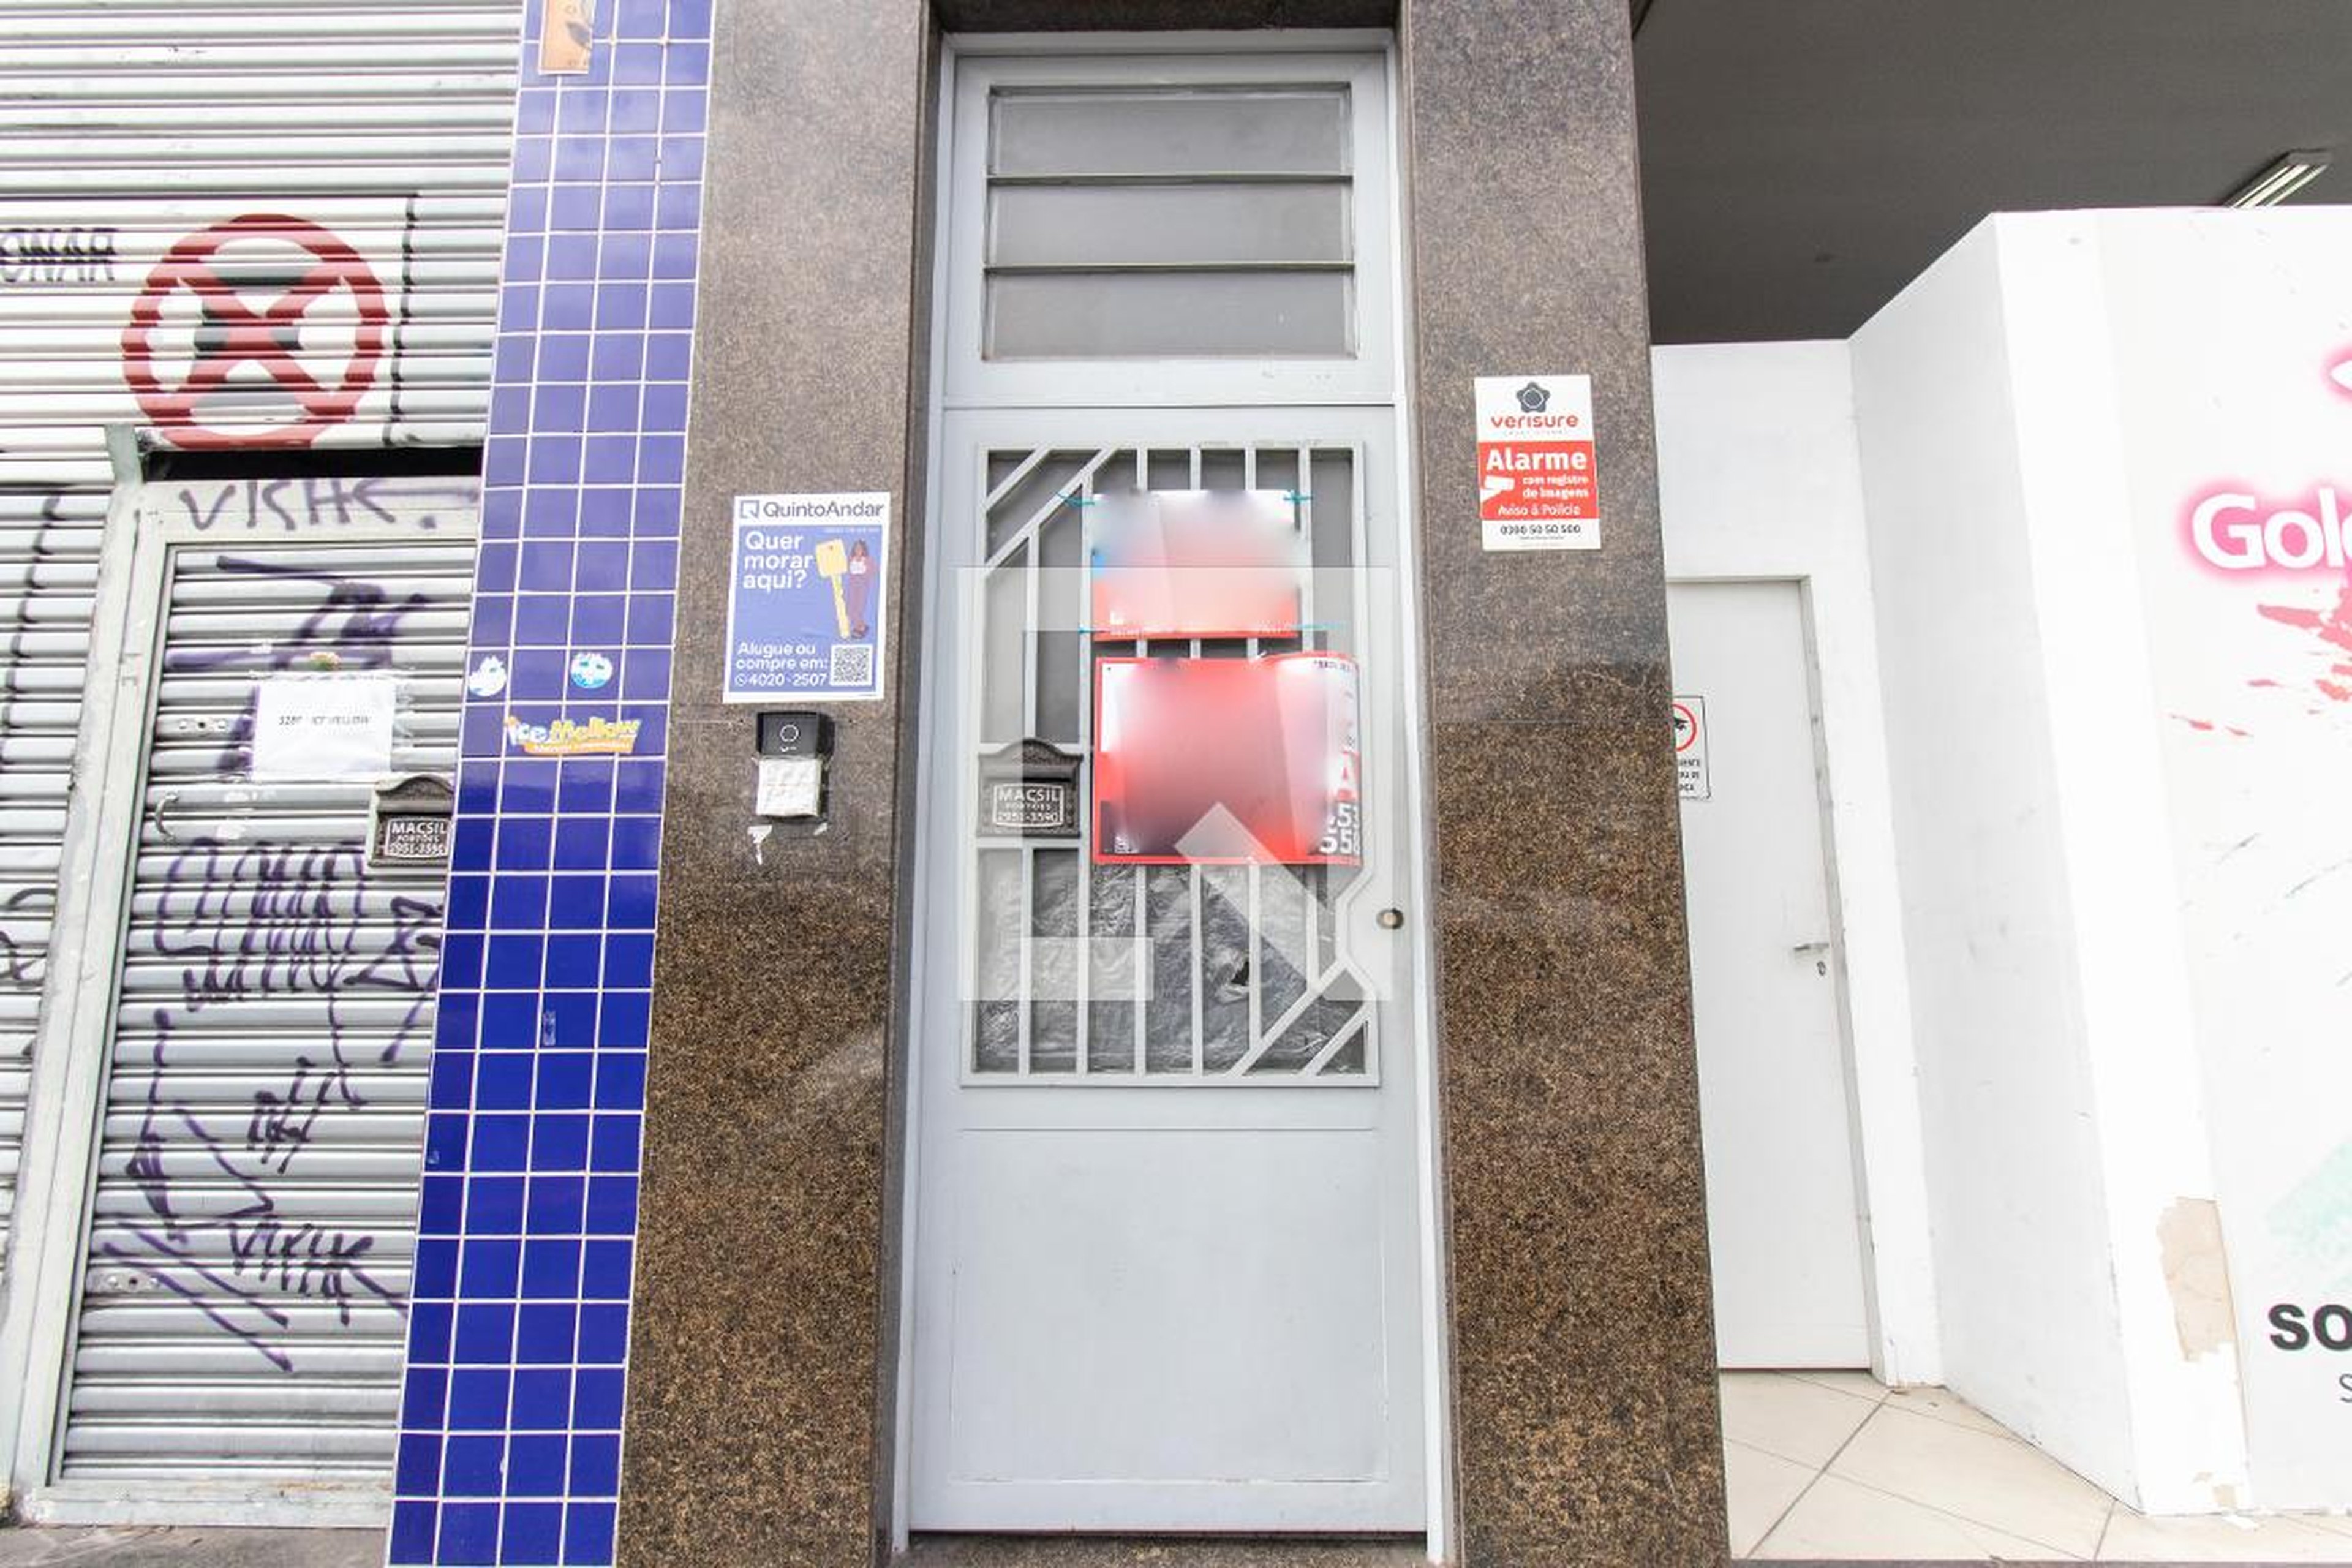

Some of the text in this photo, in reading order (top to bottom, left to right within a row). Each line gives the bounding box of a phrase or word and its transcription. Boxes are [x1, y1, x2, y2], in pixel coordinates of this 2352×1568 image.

[1491, 414, 1579, 428] verisure
[1486, 447, 1588, 470] Alarme
[1522, 488, 1538, 498] de
[763, 501, 884, 518] QuintoAndar
[2192, 488, 2352, 569] Gol
[745, 531, 804, 550] Quer
[744, 554, 813, 570] morar
[743, 570, 807, 594] aqui?
[737, 642, 816, 658] Alugue ou
[736, 658, 796, 671] compre
[998, 788, 1058, 801] MACSIL
[391, 822, 447, 834] MACSIL
